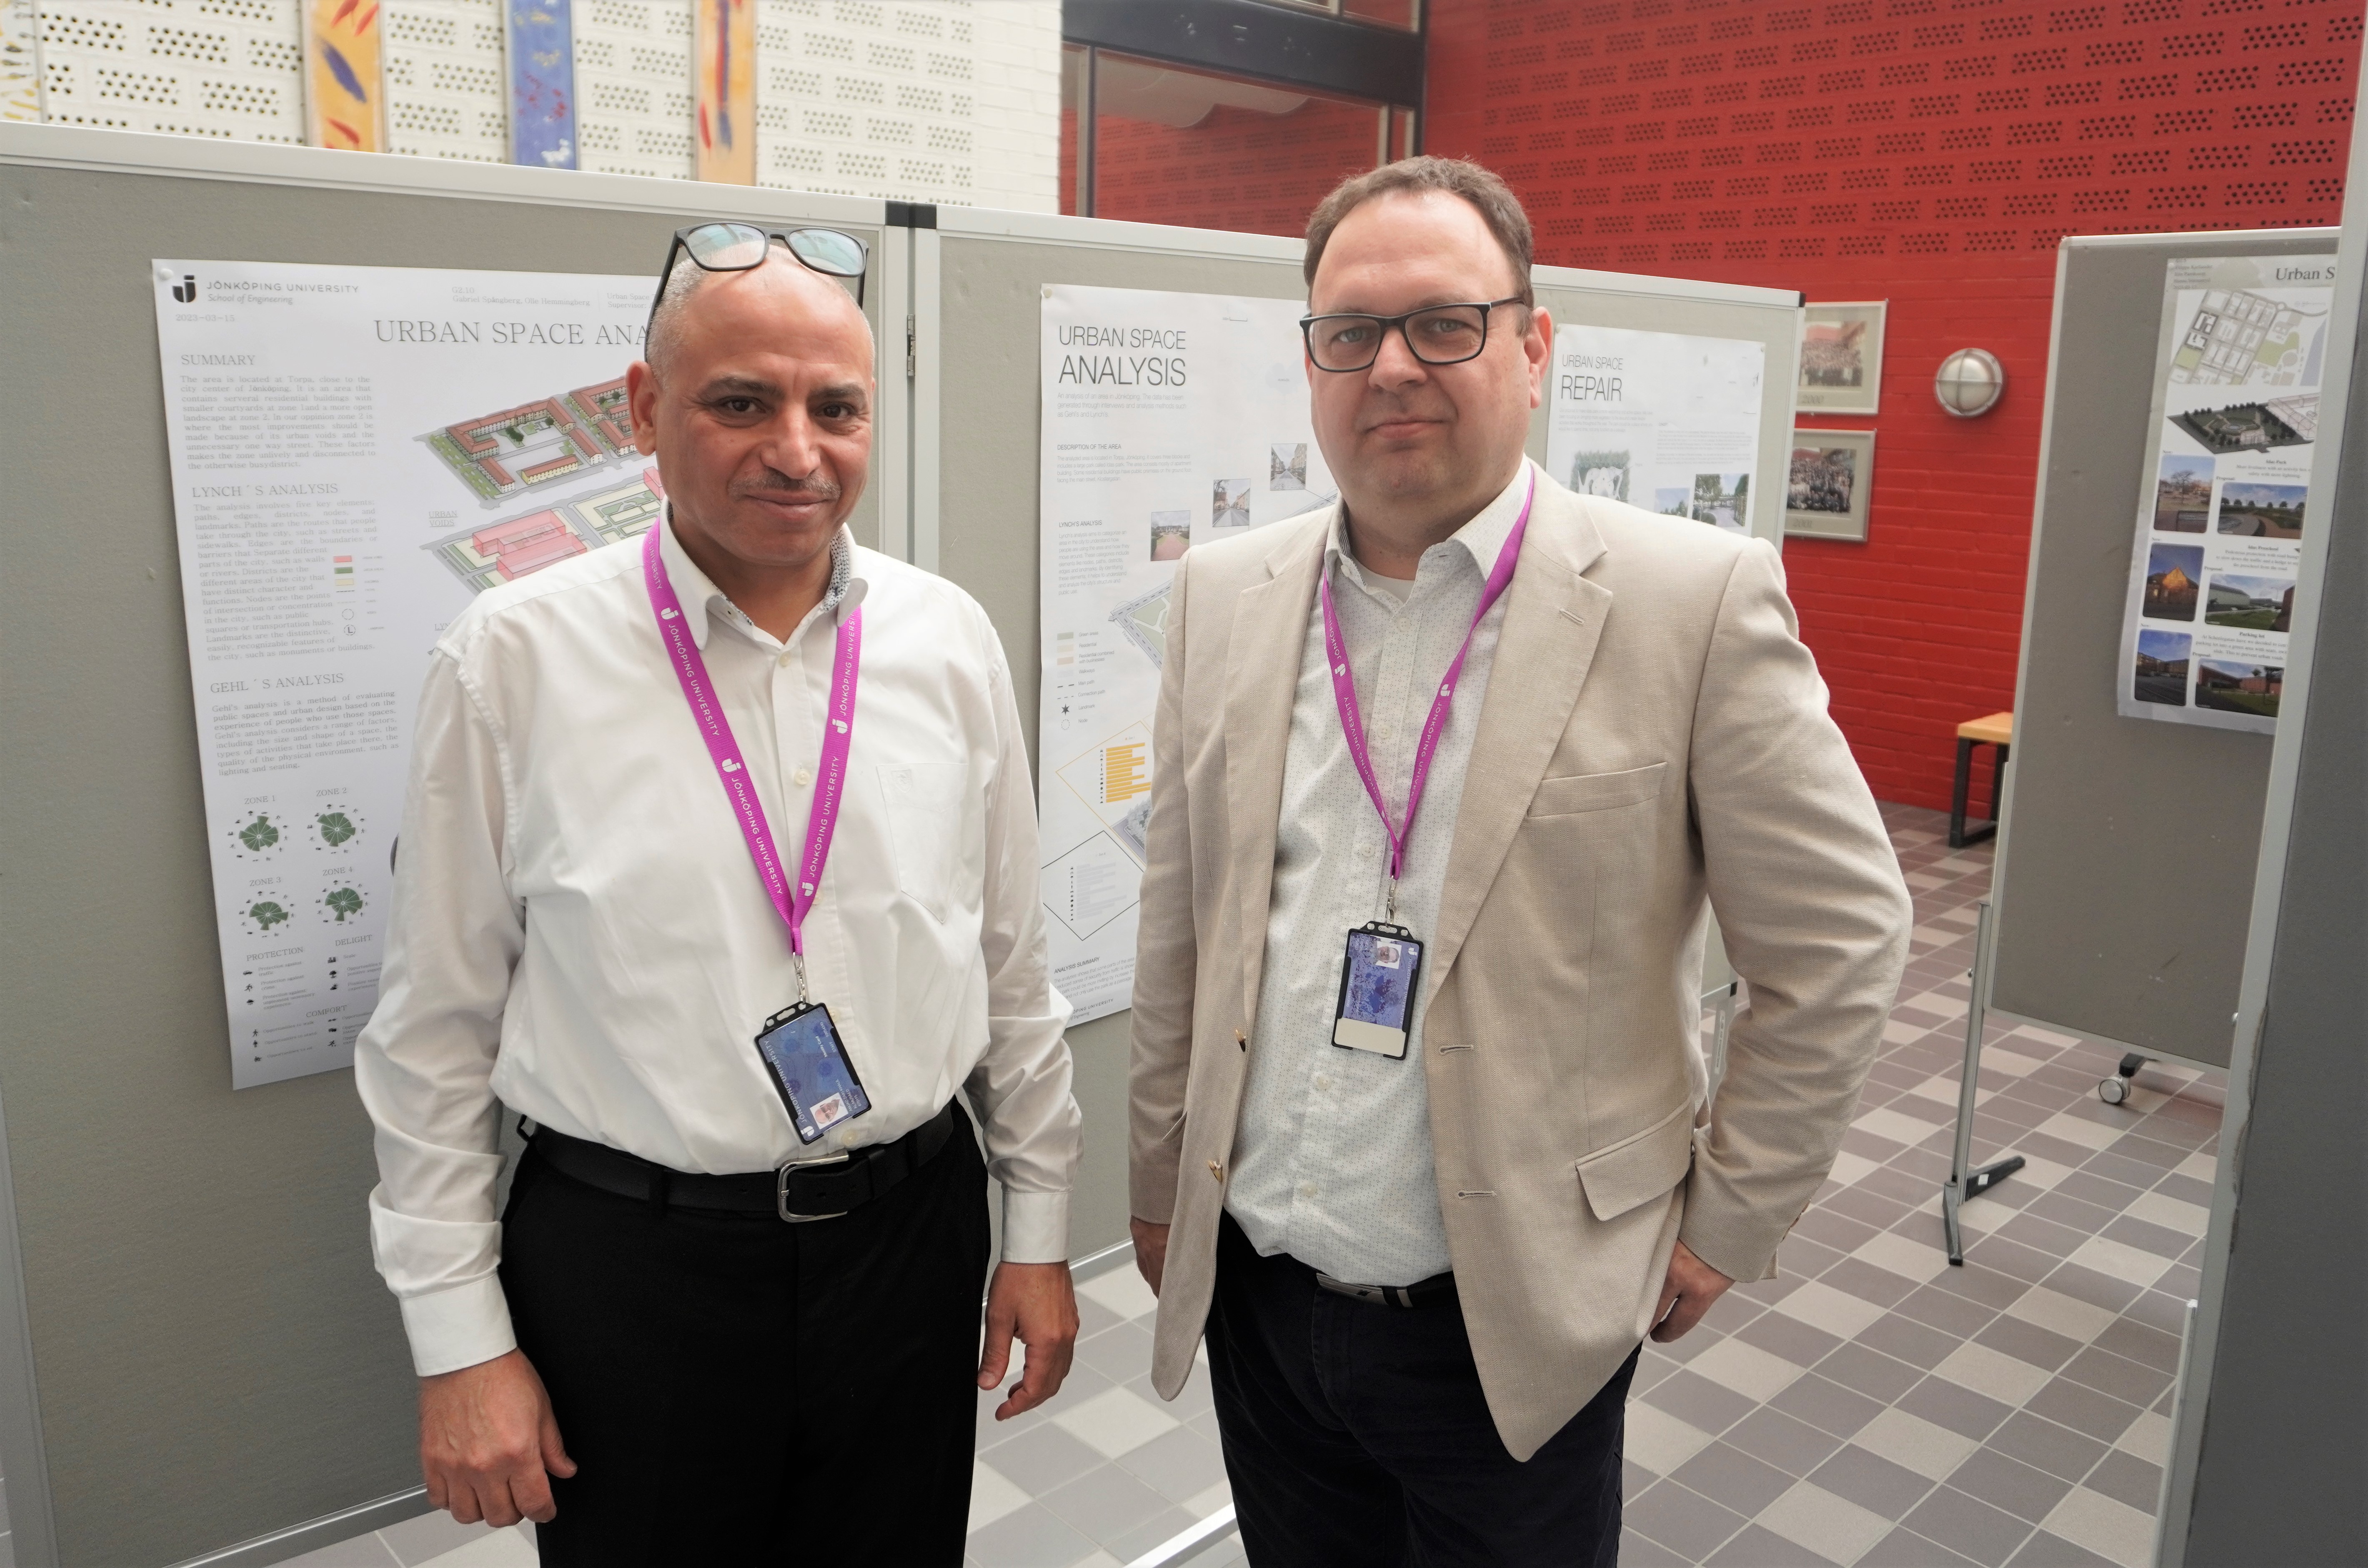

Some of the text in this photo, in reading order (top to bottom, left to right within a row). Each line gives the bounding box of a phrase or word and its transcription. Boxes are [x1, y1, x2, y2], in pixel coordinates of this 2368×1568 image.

[2276, 268, 2319, 280] Urban
[207, 280, 358, 292] JÖNKÖPING UNIVERSITY
[237, 294, 246, 304] of
[248, 295, 293, 305] Engineering
[374, 320, 479, 342] URBAN
[493, 322, 583, 344] SPACE
[1059, 325, 1185, 349] URBAN SPACE
[181, 355, 255, 365] SUMMARY
[1562, 354, 1623, 370] URBAN SPACE
[1059, 355, 1185, 386] ANALYSIS
[1561, 375, 1622, 401] REPAIR
[269, 483, 337, 495] ANALYSIS
[649, 546, 662, 589] UNIVERSITY
[276, 673, 343, 687] ANALYSIS
[668, 624, 720, 735] JÖNKÖPING UNIVERSITY
[840, 662, 852, 716] JÖNKÖPING
[1344, 697, 1360, 750] UNIVERSITY
[1421, 702, 1442, 757] JÖNKÖPING
[316, 788, 339, 796] ZONE
[810, 756, 839, 877] JÖNKÖPING UNIVERSITY
[731, 778, 783, 894] JÖNKÖPING UNIVERSITY
[323, 867, 345, 875] ZONE
[249, 878, 273, 886] ZONE
[335, 934, 372, 946] DELIGHT
[247, 947, 303, 961] PROTECTION
[1054, 957, 1100, 974] ANALYSIS SUMMARY
[306, 1005, 346, 1017] COMFORT
[1088, 998, 1114, 1010] UNIVERSITY
[763, 1040, 807, 1123] JÖNKÖPING UNIVERSITY
